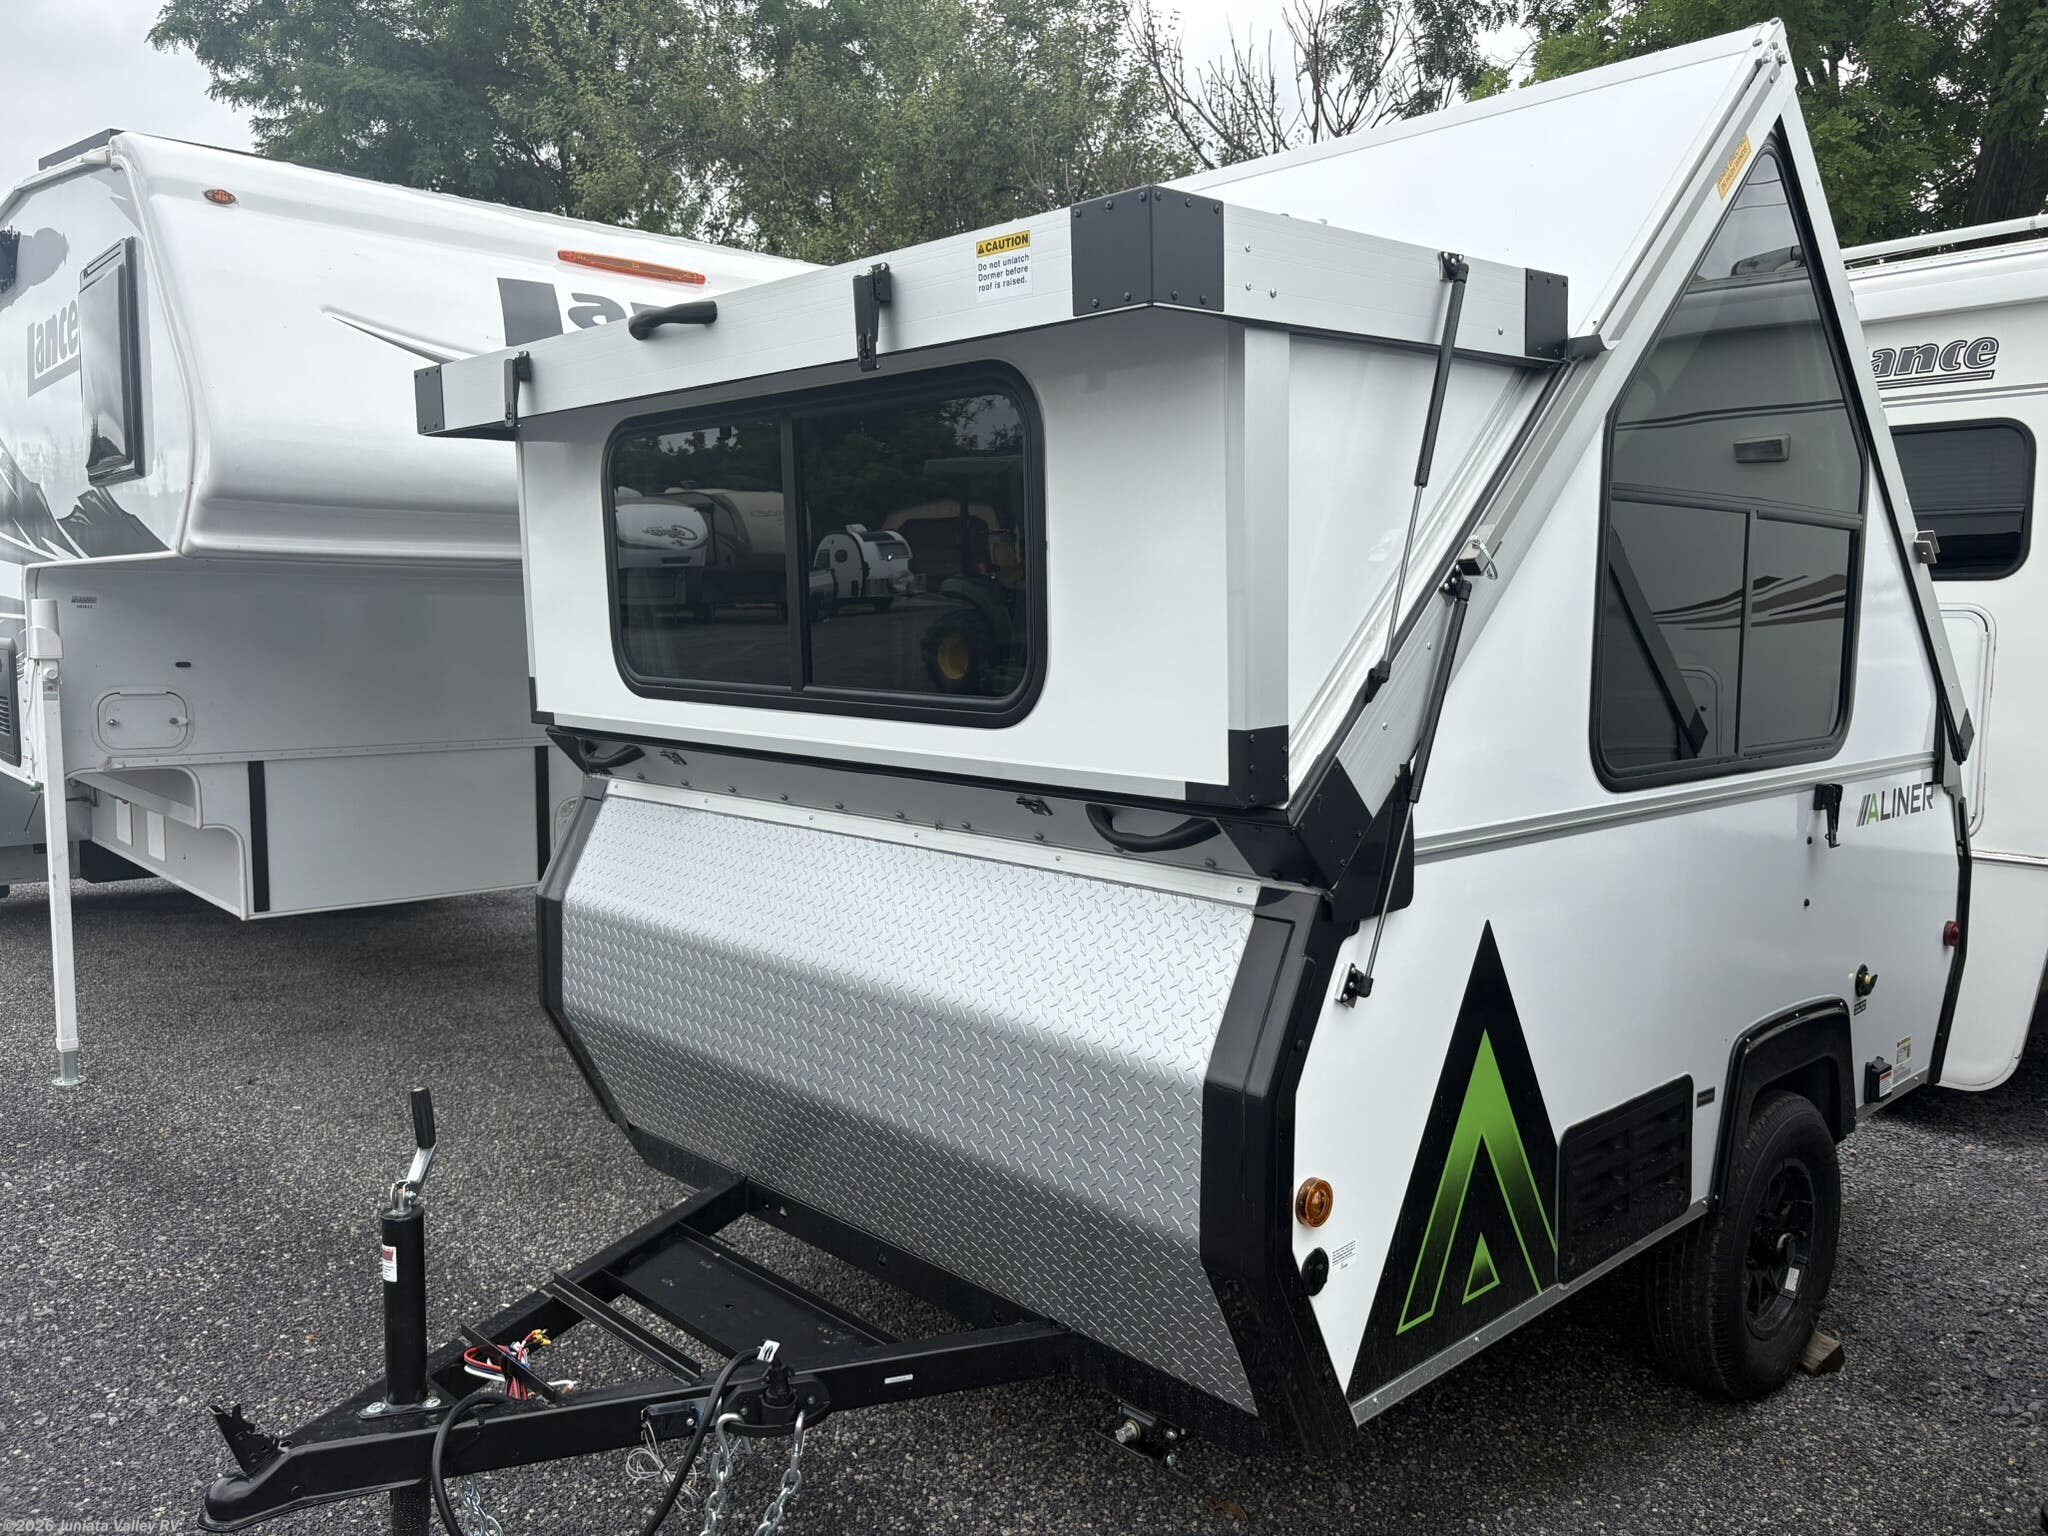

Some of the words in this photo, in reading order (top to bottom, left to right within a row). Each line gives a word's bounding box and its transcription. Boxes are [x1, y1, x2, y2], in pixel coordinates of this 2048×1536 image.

[985, 233, 1028, 252] CAUTION
[989, 260, 1000, 269] not
[1003, 254, 1029, 266] unlatch
[978, 270, 1003, 282] Dormer
[1005, 265, 1028, 276] before
[978, 282, 993, 293] roof
[27, 299, 80, 398] Lance
[1871, 336, 1999, 388] ance
[1866, 783, 1933, 824] ALINER
